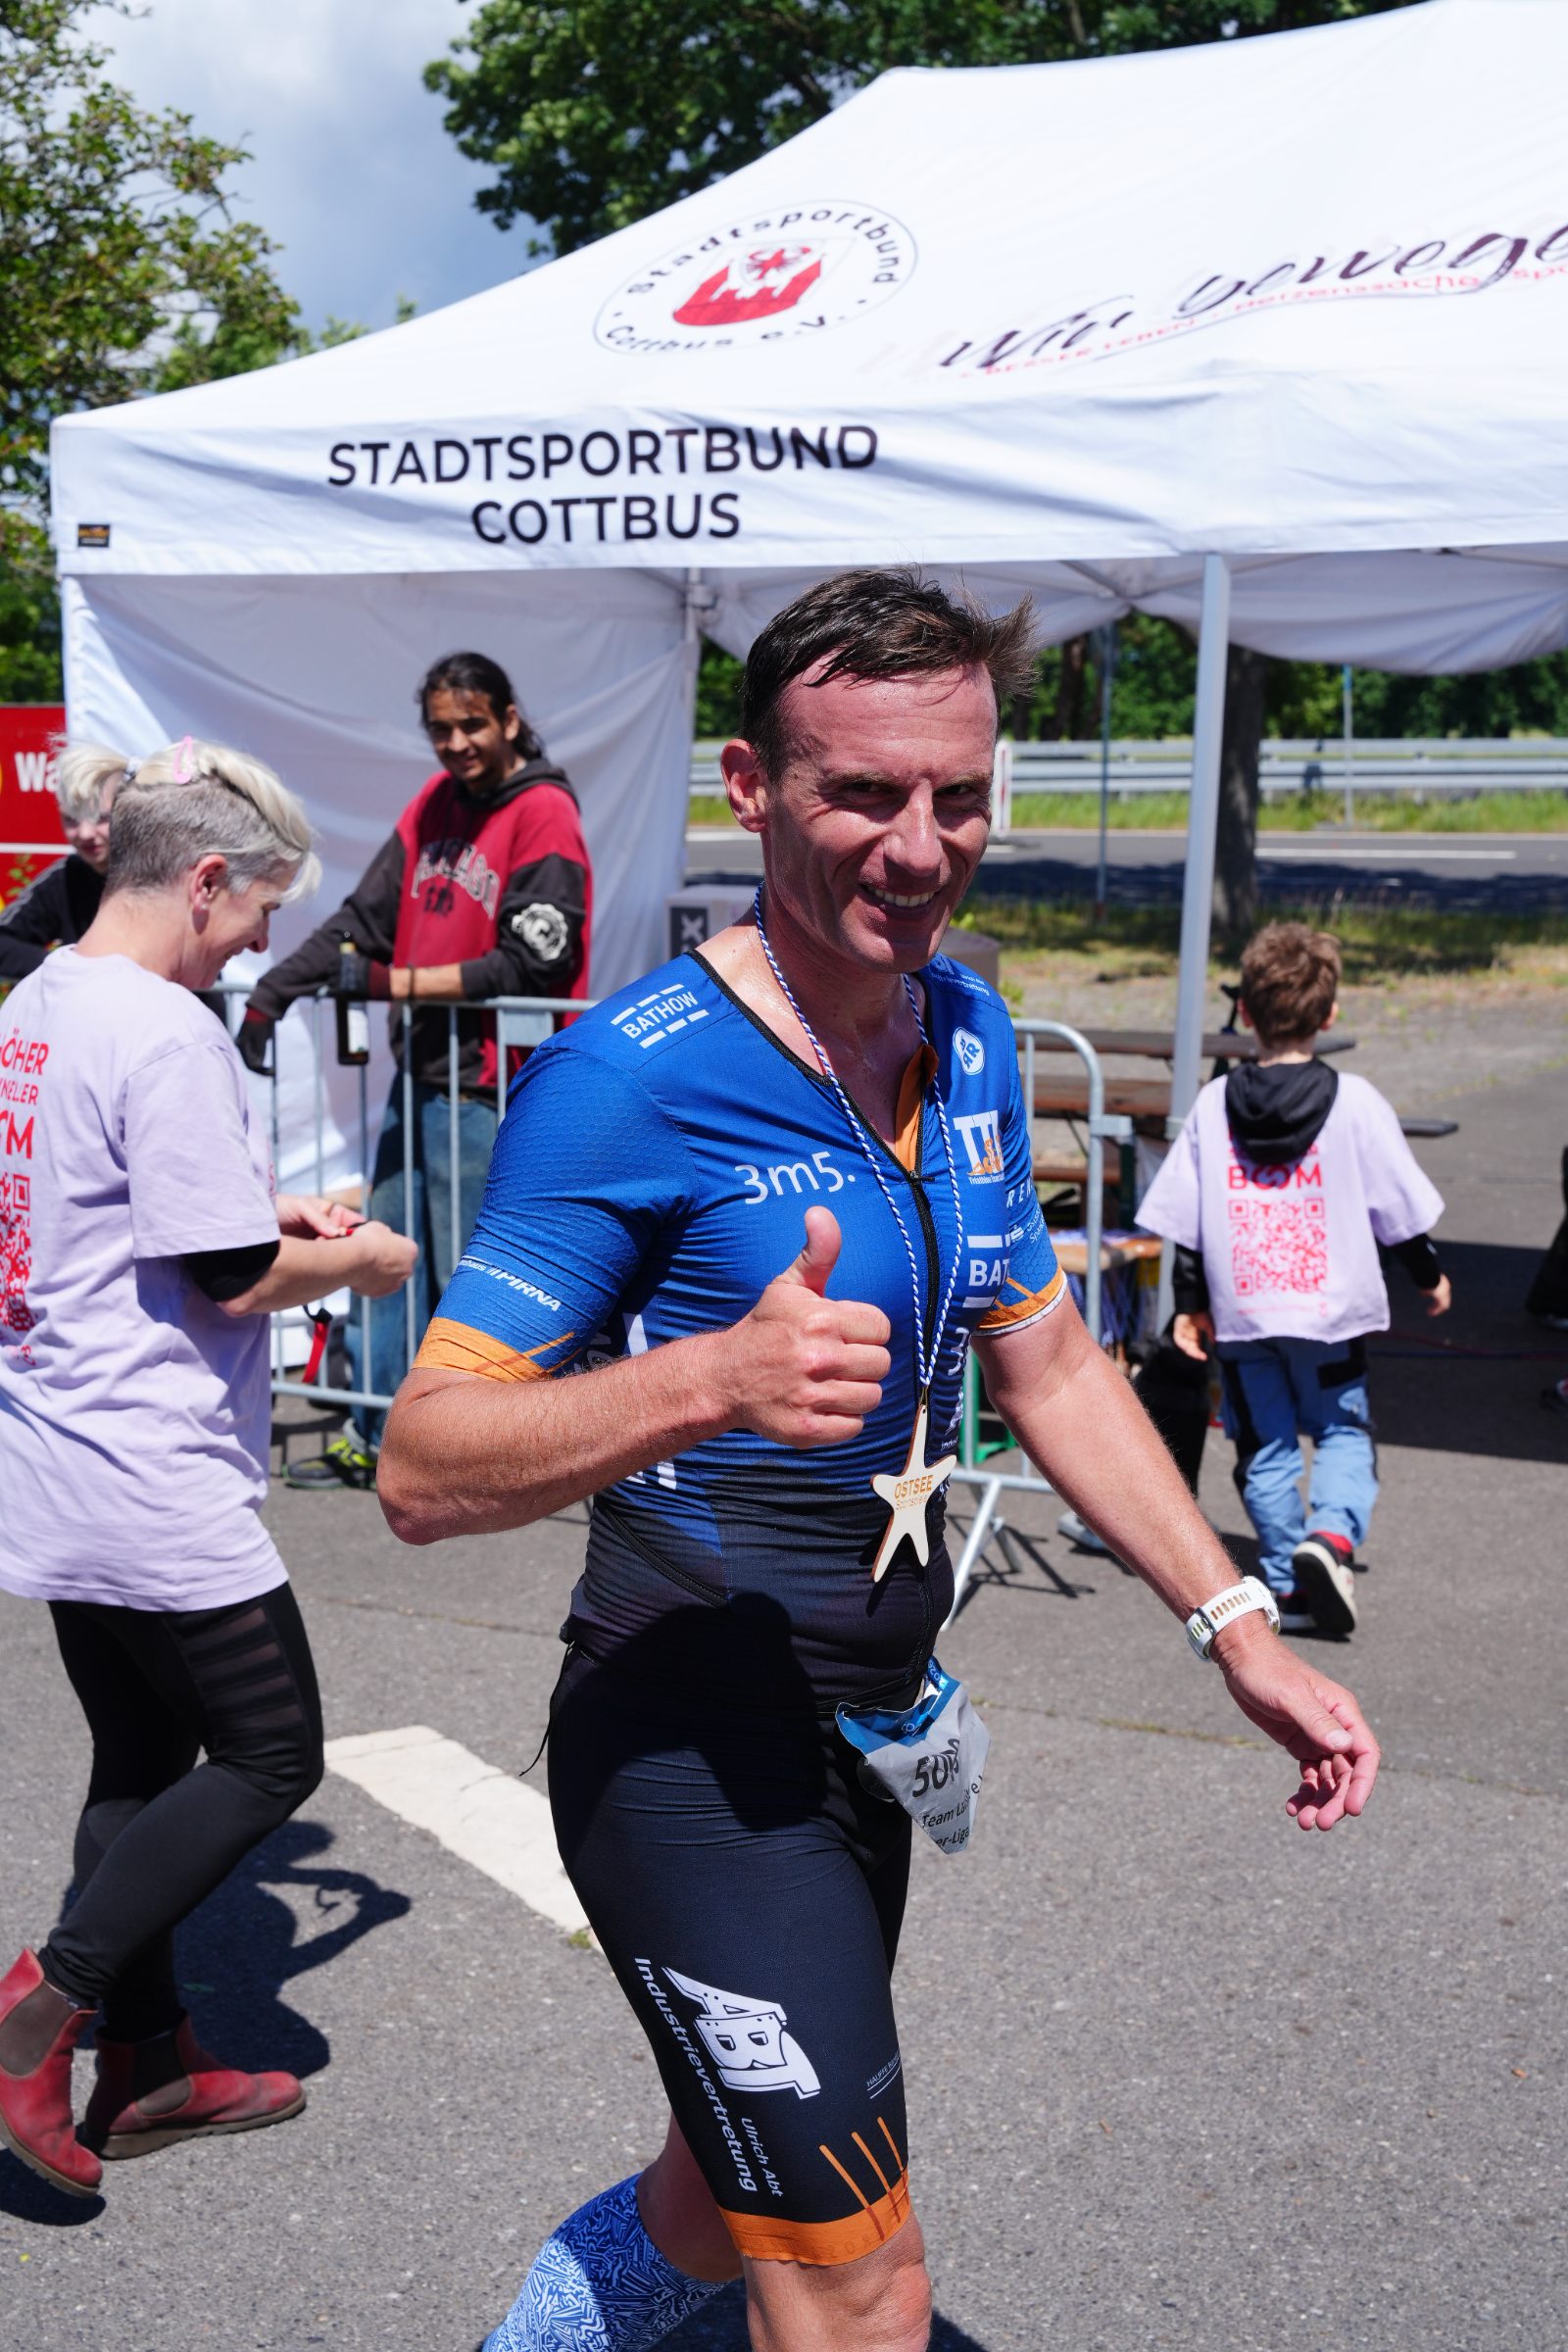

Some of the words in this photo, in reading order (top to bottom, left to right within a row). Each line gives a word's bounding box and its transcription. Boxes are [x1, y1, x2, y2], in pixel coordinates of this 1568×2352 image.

[627, 209, 899, 294] Stadtsportbund
[606, 325, 733, 352] Cottbus
[328, 425, 879, 487] STADTSPORTBUND
[471, 493, 741, 544] COTTBUS
[620, 991, 699, 1039] BATHOW
[735, 1152, 856, 1204] 3m5.
[1228, 1163, 1322, 1190] BOOM
[894, 1475, 934, 1499] OSTSEE
[922, 1810, 956, 1830] Team
[661, 1966, 821, 2100] ABT
[634, 1958, 759, 2192] Industrievertretung
[742, 2117, 769, 2165] Ulrich
[762, 2168, 784, 2197] Abt
